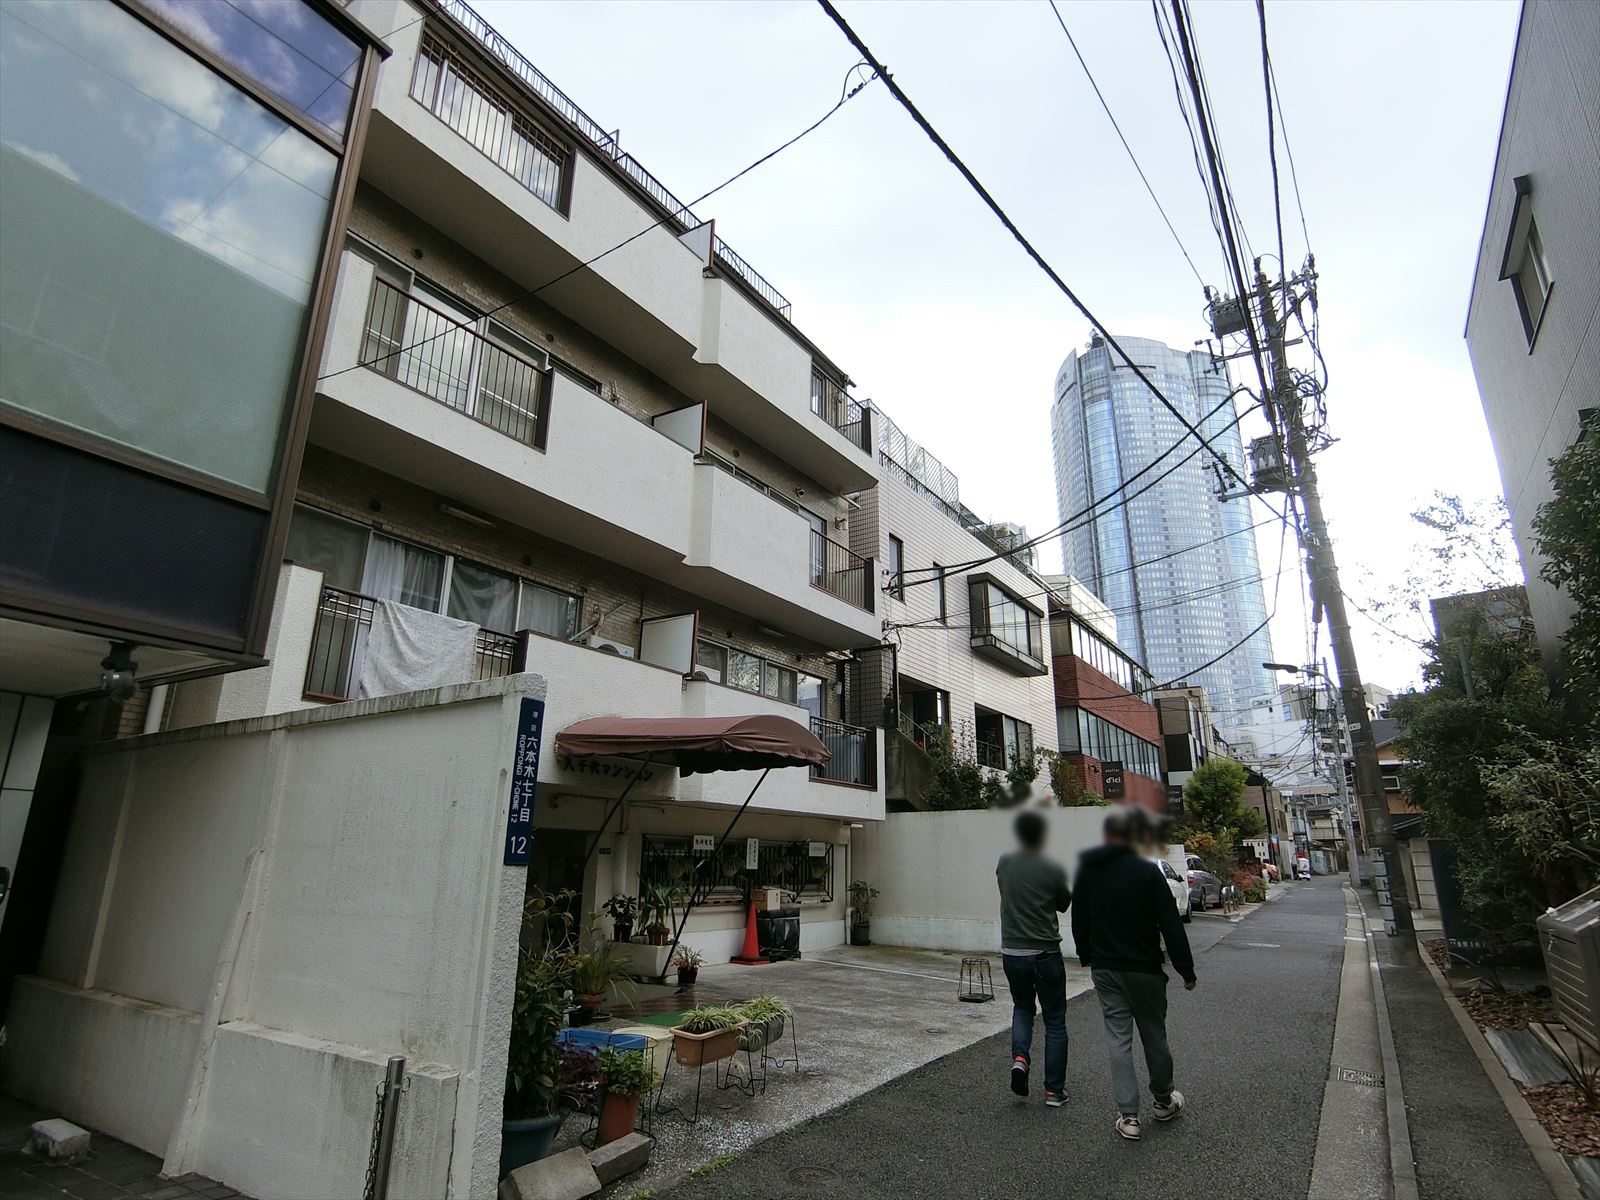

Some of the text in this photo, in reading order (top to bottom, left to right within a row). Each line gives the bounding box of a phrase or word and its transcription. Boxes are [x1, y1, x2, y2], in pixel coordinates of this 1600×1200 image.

[510, 734, 527, 823] ROPPONGI 7-CHOME 12
[519, 736, 539, 822] 六本木七丁目
[510, 835, 527, 855] 12
